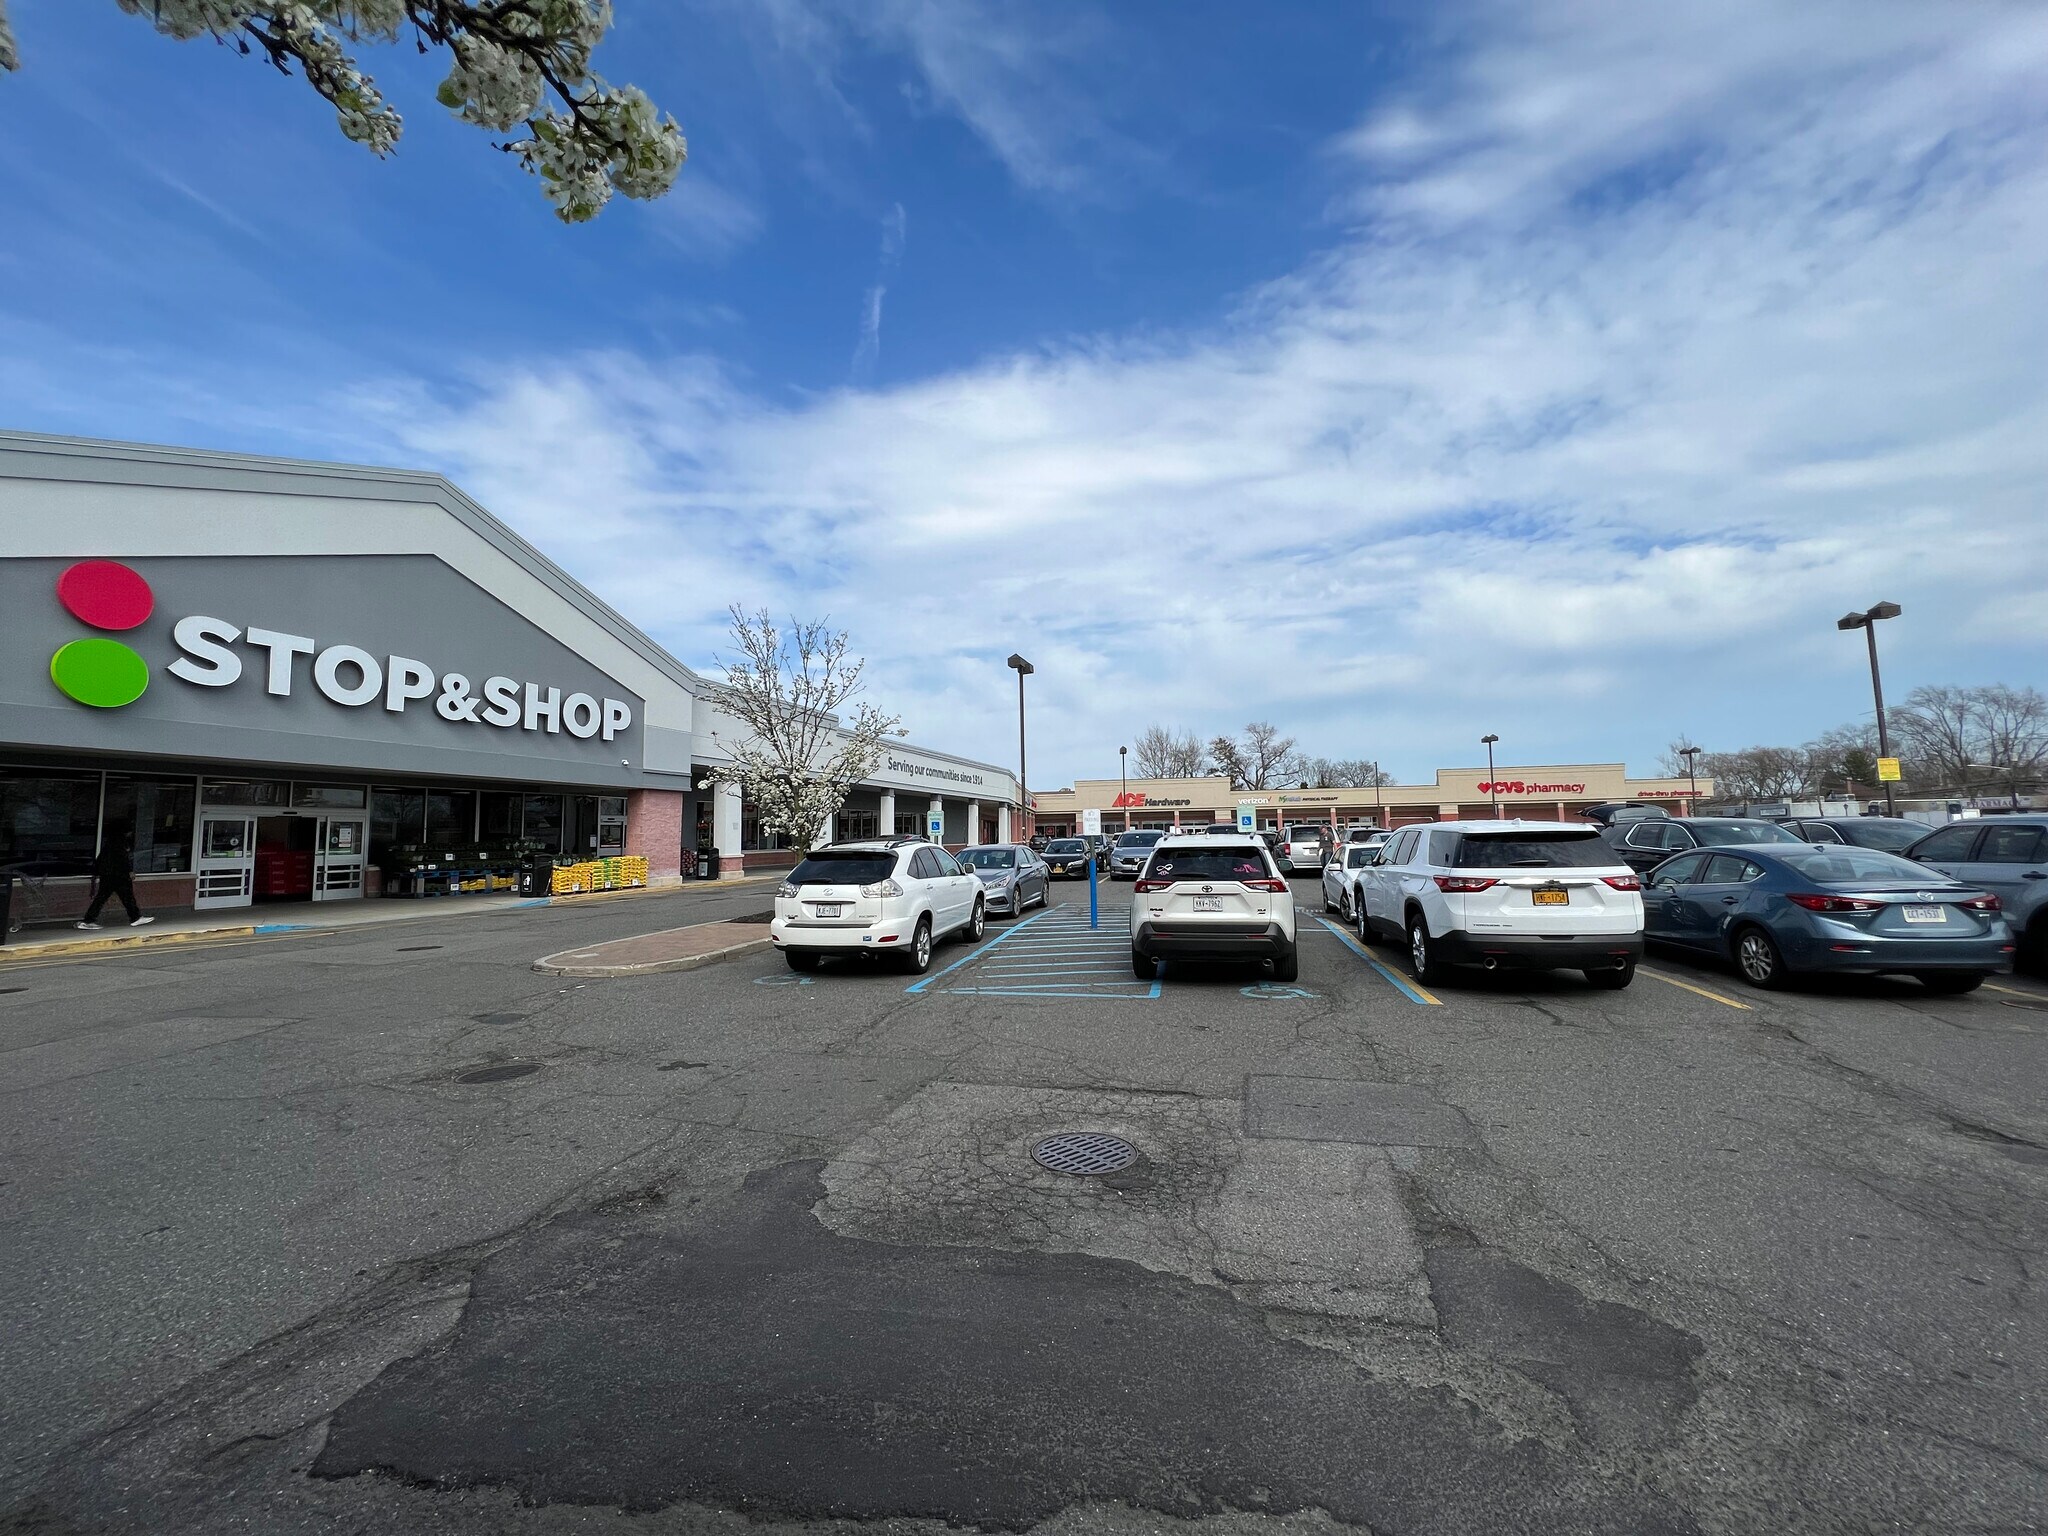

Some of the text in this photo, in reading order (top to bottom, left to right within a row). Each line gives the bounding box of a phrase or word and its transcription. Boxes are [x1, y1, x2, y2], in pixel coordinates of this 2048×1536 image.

[167, 615, 632, 741] STOP&SHOP
[887, 756, 983, 786] Serving our communities since 1914
[1492, 781, 1585, 796] CVS pharmacy
[1112, 791, 1191, 808] ACE Hardware
[1237, 796, 1269, 806] verizon
